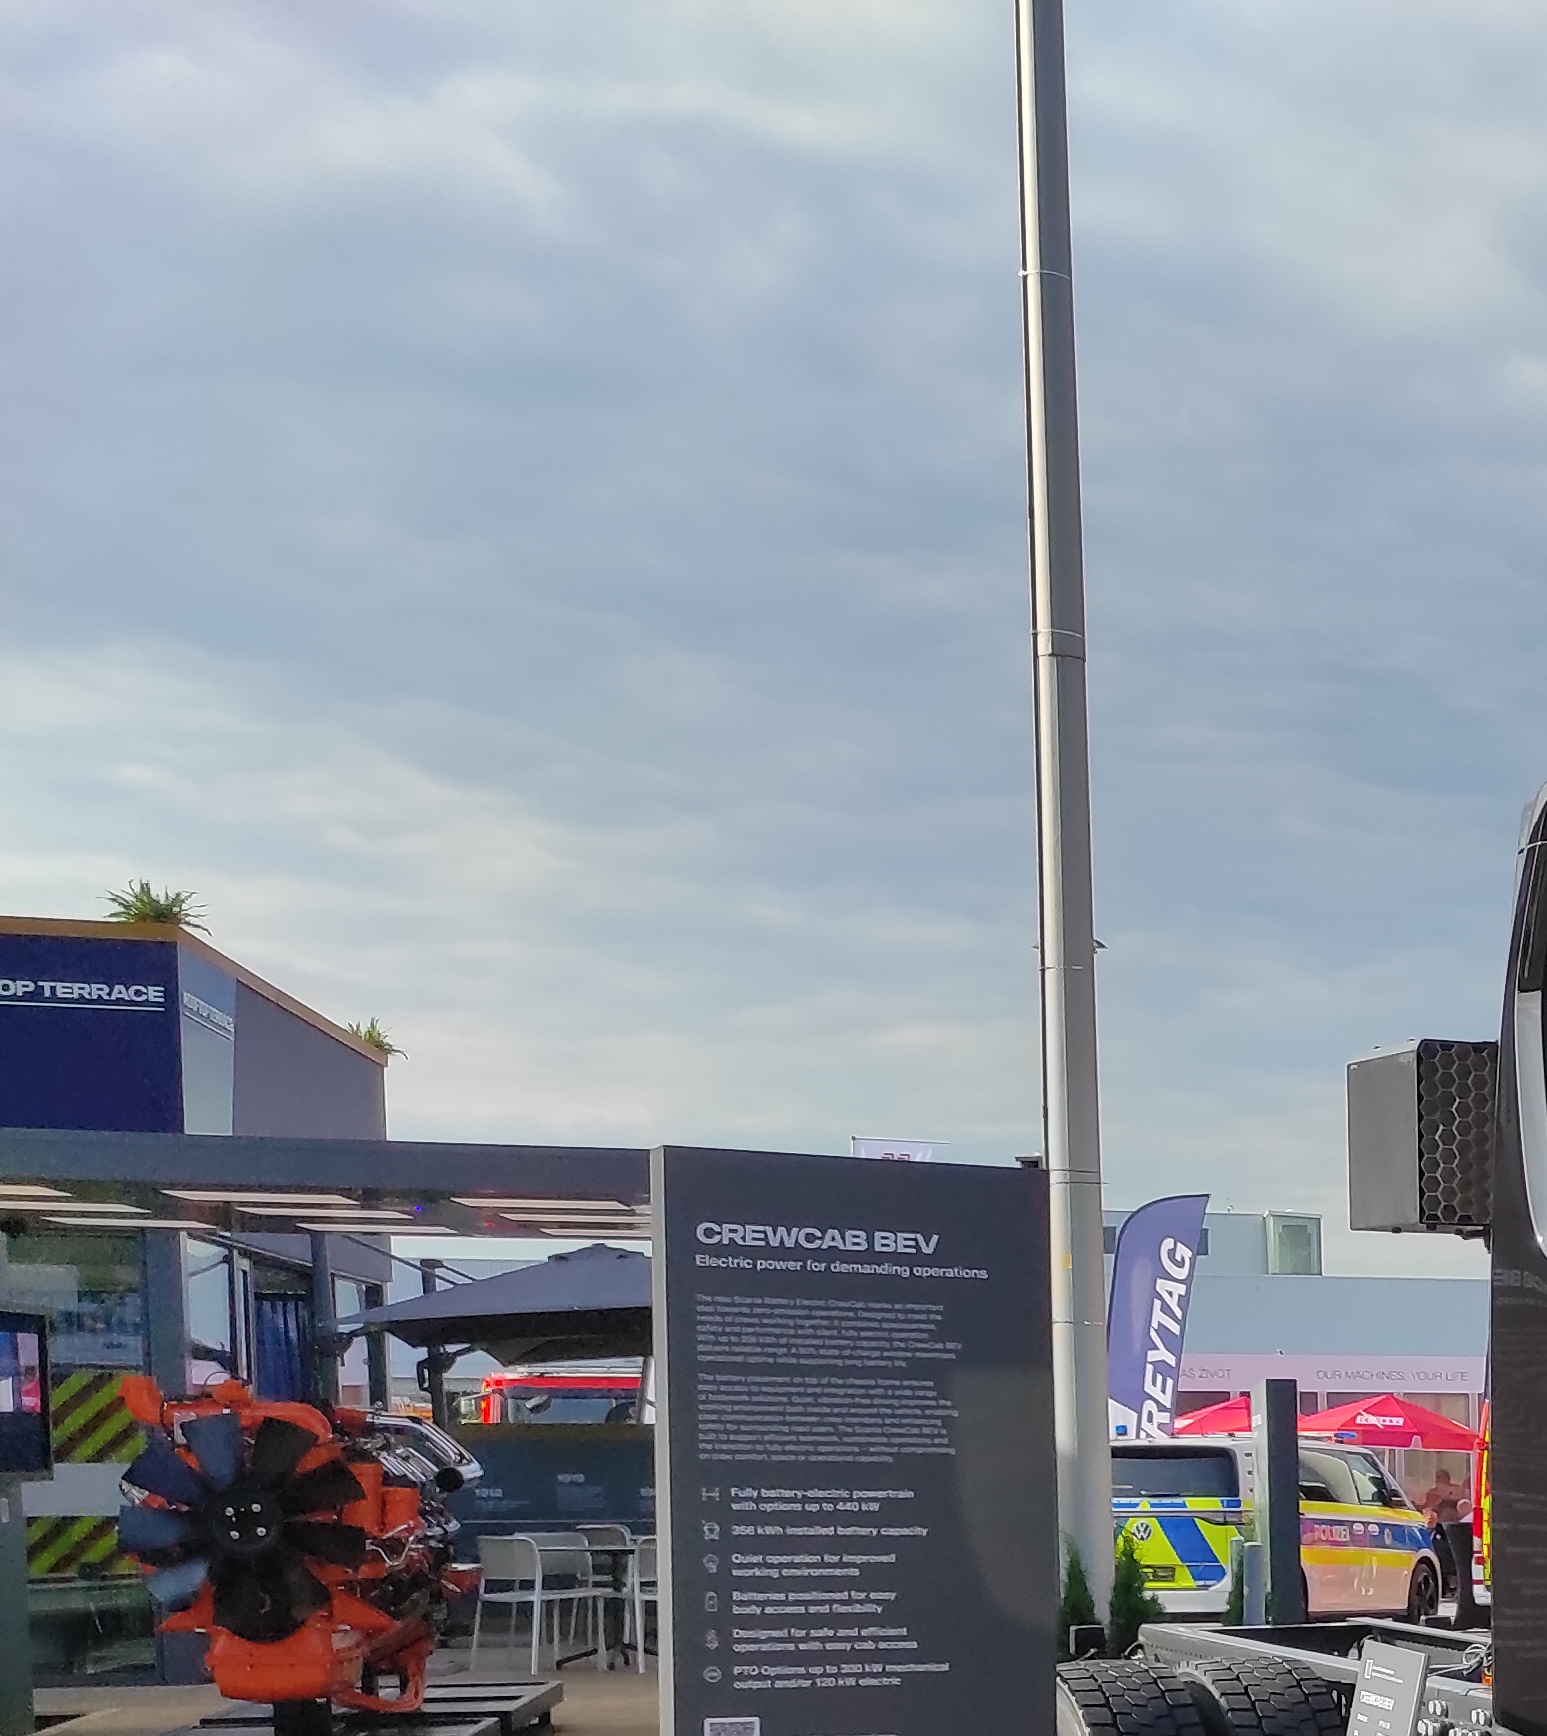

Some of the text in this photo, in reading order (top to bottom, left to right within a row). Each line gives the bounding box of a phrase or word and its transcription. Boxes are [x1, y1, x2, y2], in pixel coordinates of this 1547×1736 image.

[37, 981, 165, 1003] TERRACE
[696, 1222, 940, 1255] CREWCAB BEV
[694, 1253, 989, 1281] Electric power for demanding operations
[1140, 1237, 1193, 1440] REYTAG
[1316, 1369, 1342, 1380] OUR
[1410, 1371, 1443, 1381] YOUR
[731, 1487, 759, 1499] Fully
